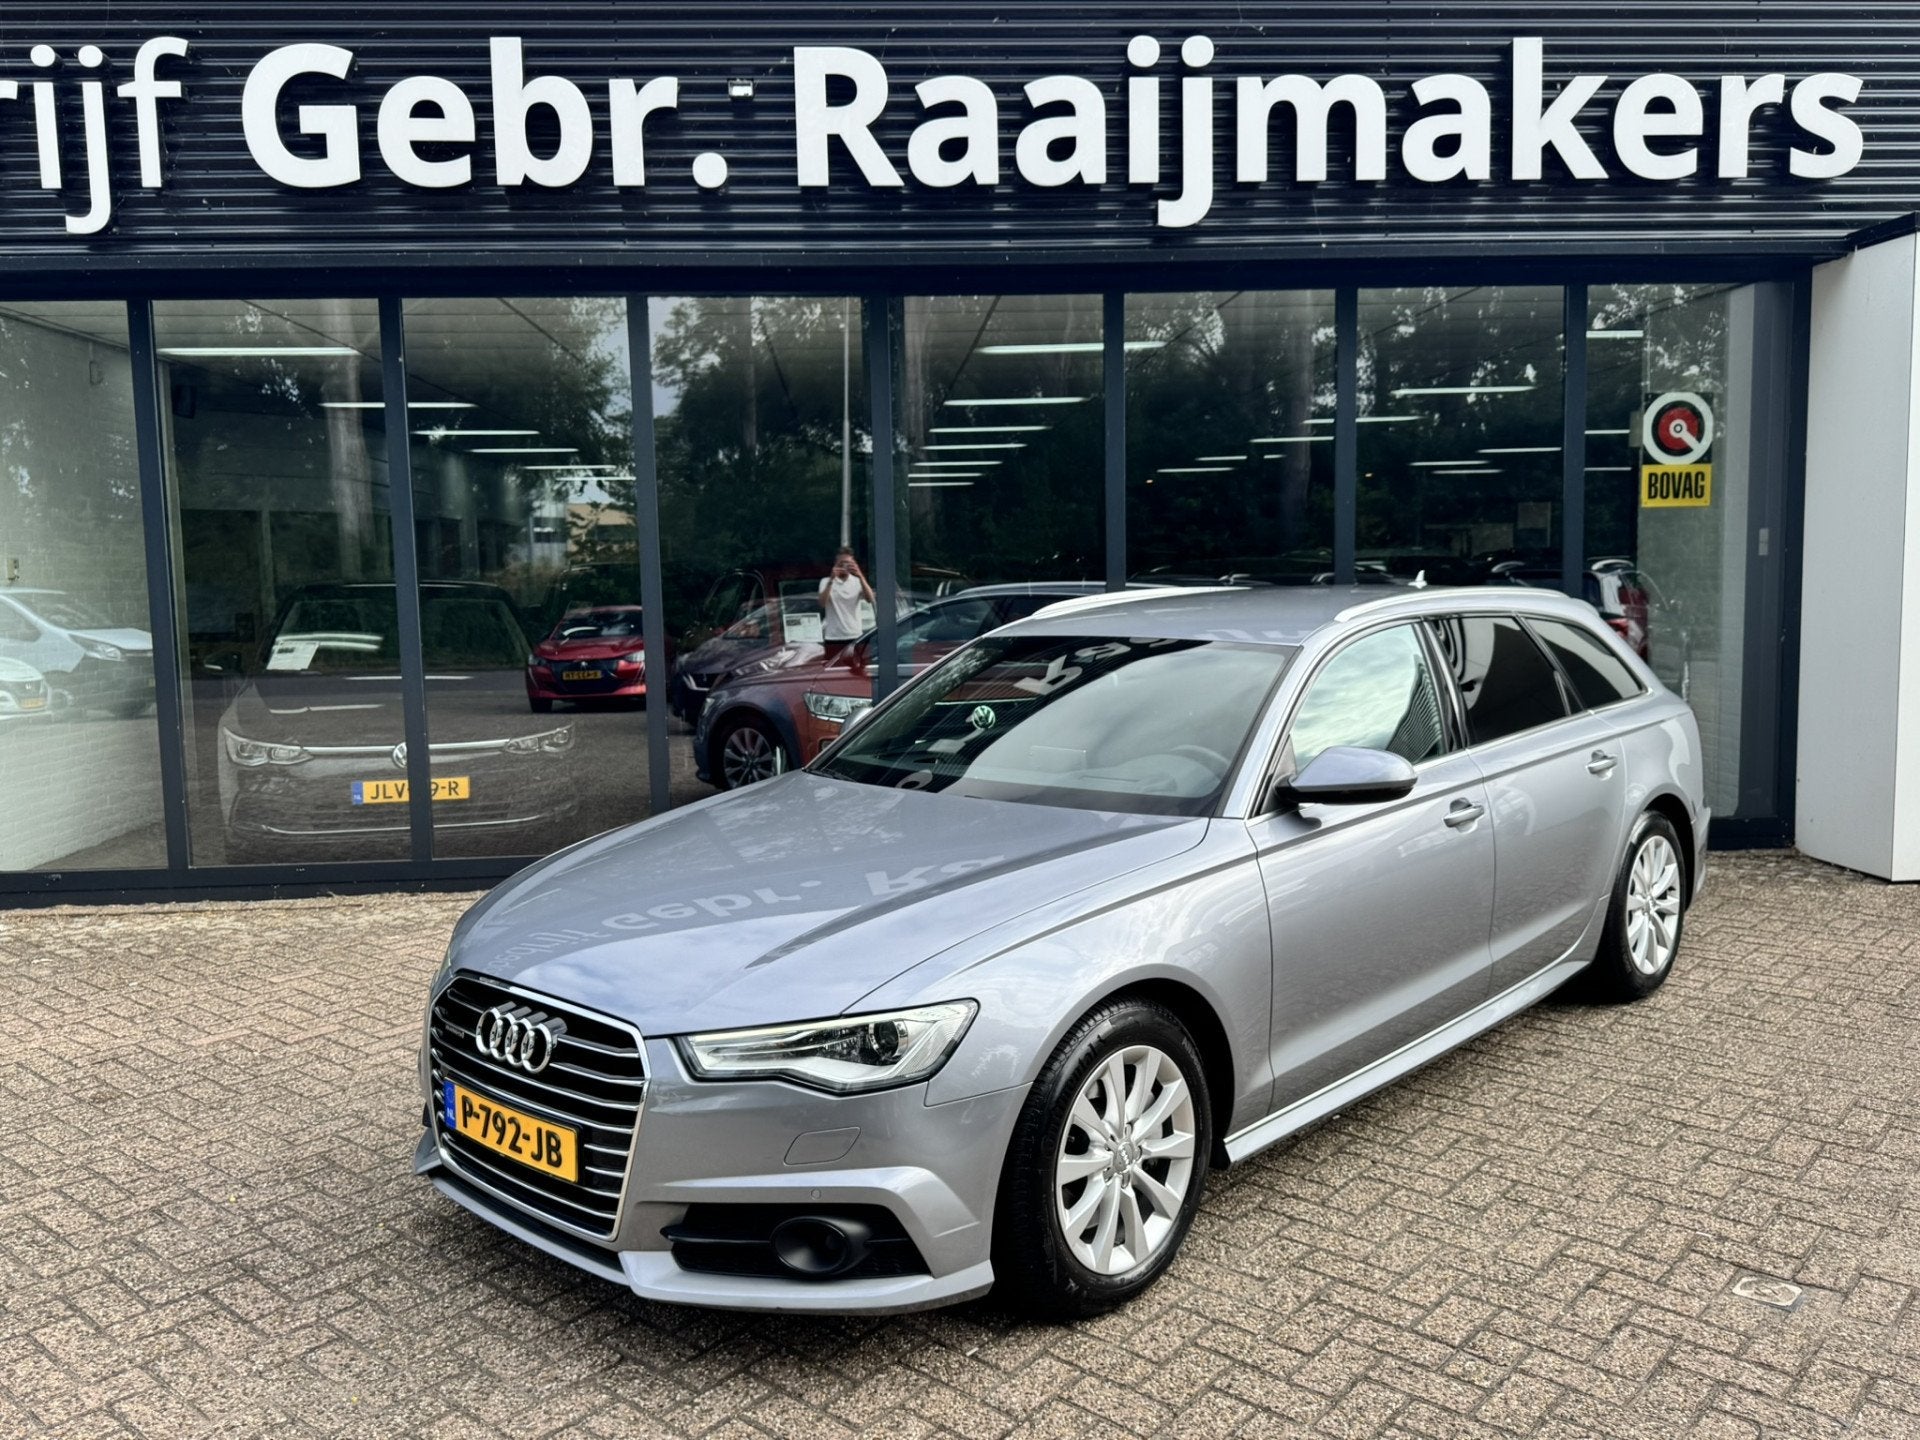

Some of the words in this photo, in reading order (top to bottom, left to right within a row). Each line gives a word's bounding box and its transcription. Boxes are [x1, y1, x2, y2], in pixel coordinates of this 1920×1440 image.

[0, 36, 188, 234] ijf
[242, 37, 728, 188] Gebr.
[793, 36, 1864, 228] Raaijmakers
[1648, 471, 1706, 500] BOVAG
[370, 780, 460, 800] JLV-9-R
[461, 1094, 564, 1169] P-792-JB
